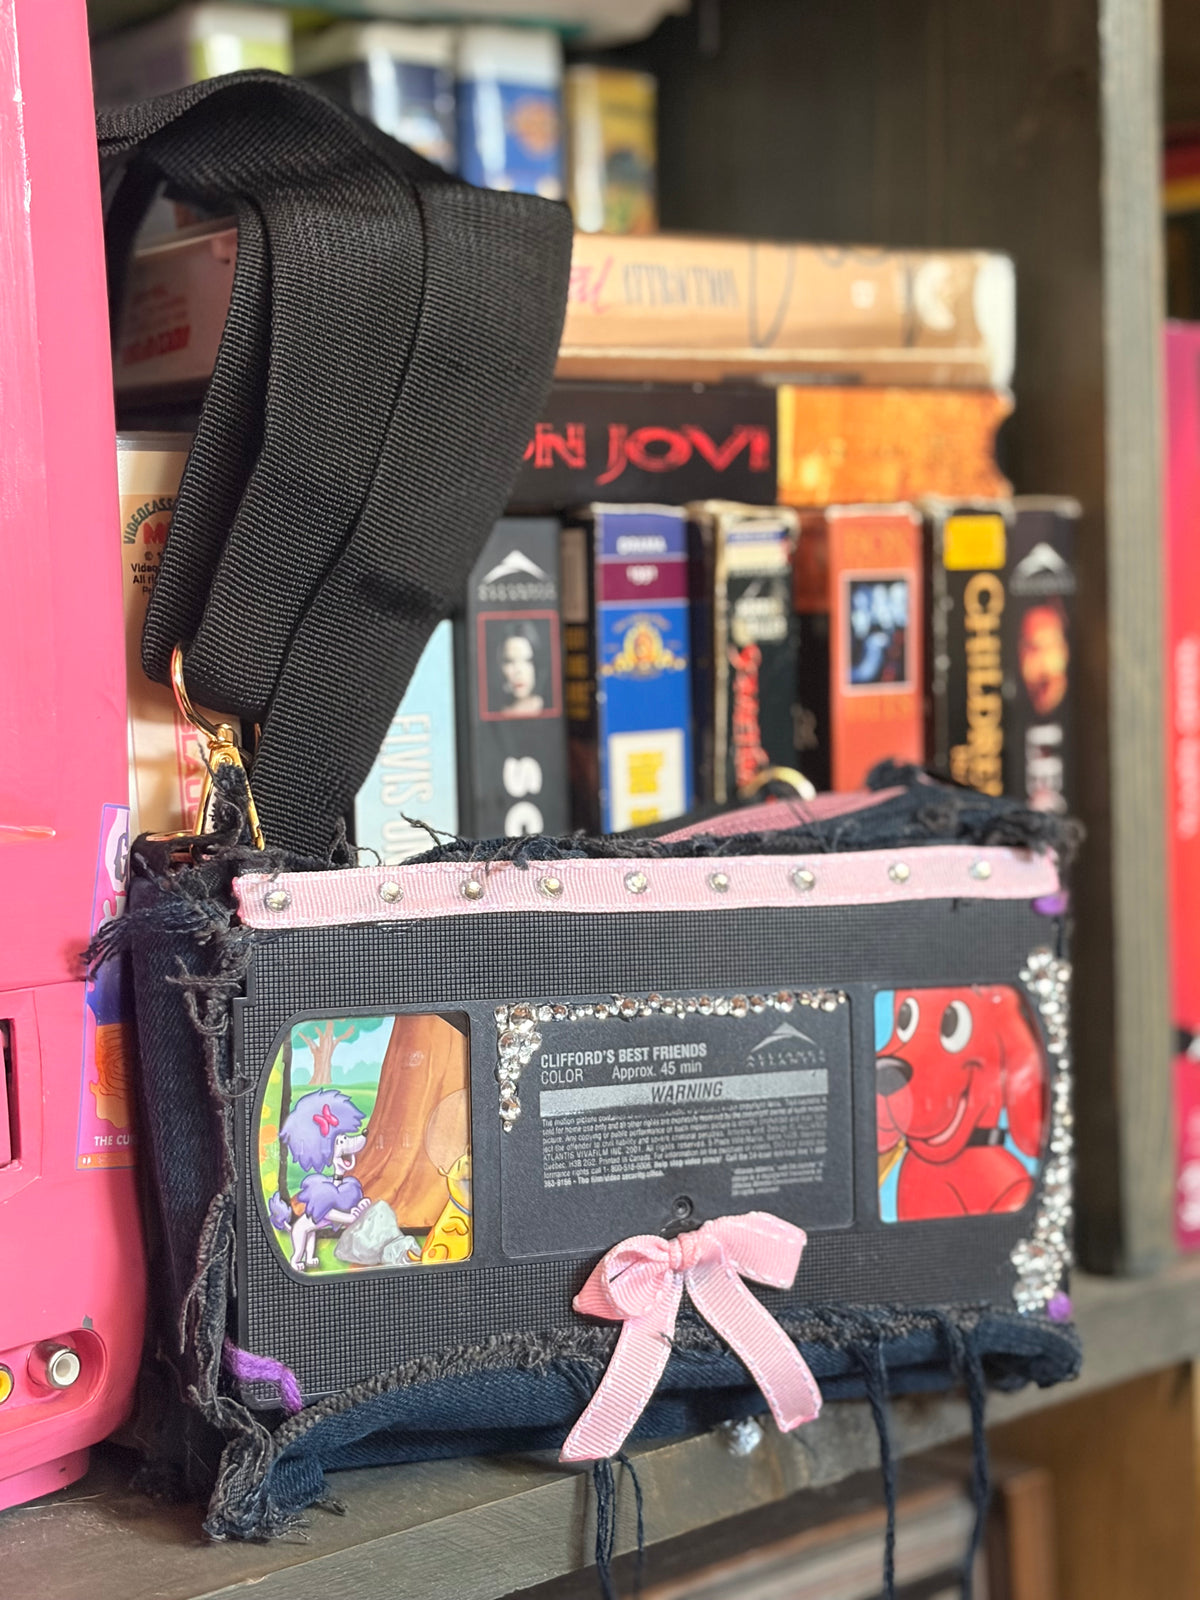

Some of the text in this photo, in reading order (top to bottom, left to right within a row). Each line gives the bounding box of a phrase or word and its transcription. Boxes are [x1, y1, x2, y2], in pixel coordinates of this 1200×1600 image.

[595, 422, 771, 486] JOVI
[541, 1043, 707, 1069] CLIFFORD'S BEST FRIENDS
[541, 1060, 703, 1084] COLOR Approx. 45 min
[651, 1082, 723, 1101] WARNING
[542, 1118, 552, 1127] The
[564, 1125, 580, 1133] home
[94, 1135, 113, 1146] THE
[543, 1150, 574, 1161] ATLANTIS
[576, 1148, 608, 1158] VIVAFILM
[590, 1165, 602, 1174] call
[578, 1176, 590, 1185] The
